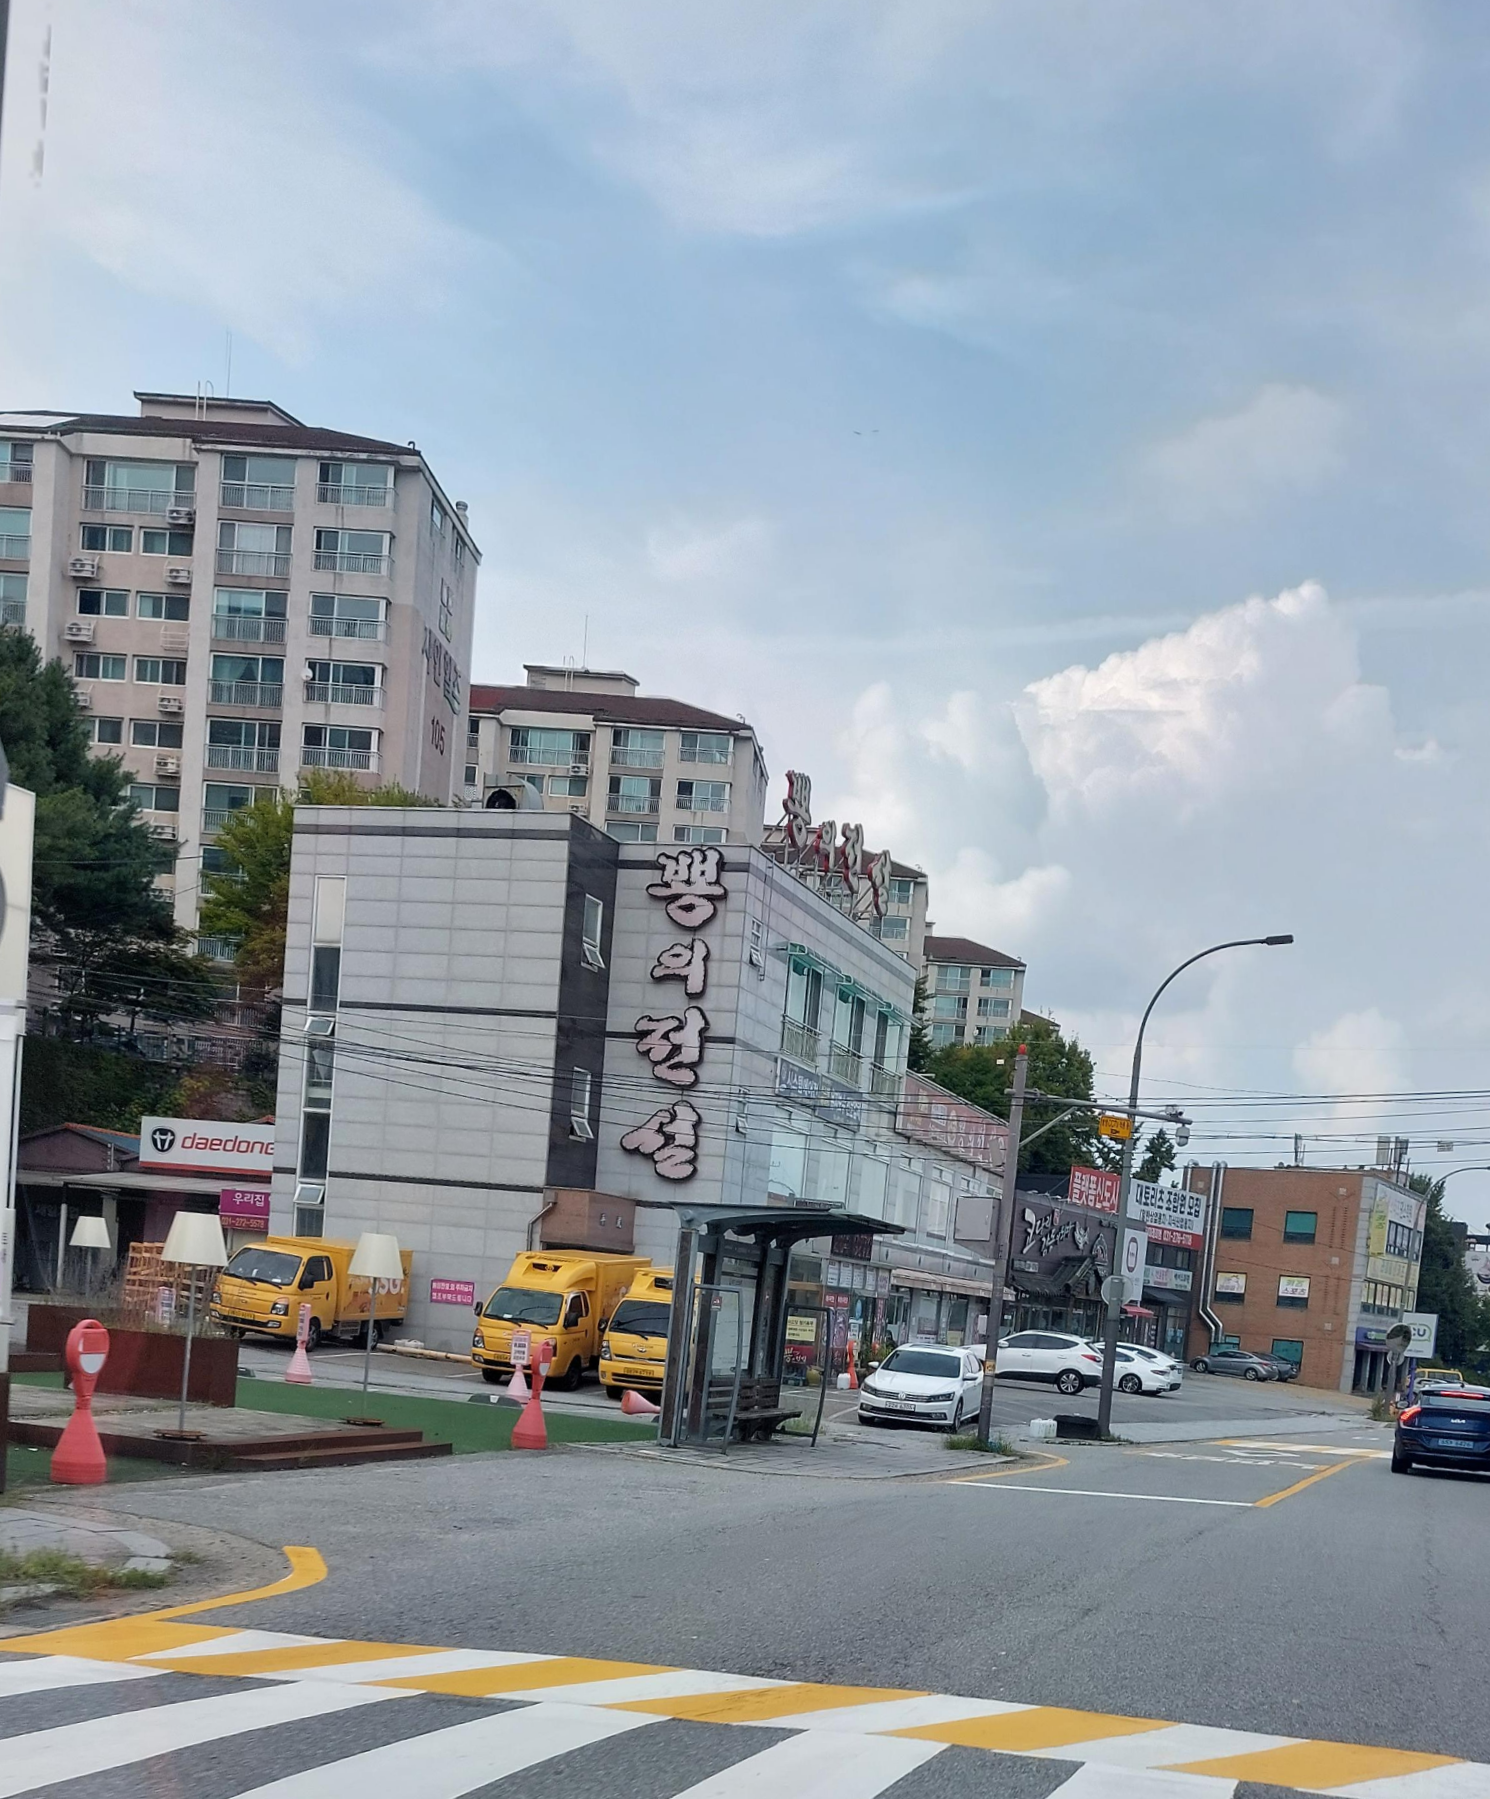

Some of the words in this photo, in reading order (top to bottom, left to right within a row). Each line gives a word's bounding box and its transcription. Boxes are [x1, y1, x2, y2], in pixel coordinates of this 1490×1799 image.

[431, 716, 446, 756] 105
[620, 846, 727, 1181] 뽕의전설
[232, 1192, 265, 1207] 우리집
[1072, 1171, 1120, 1213] 플랫폼신도시
[1165, 1190, 1186, 1215] 조합원
[1187, 1195, 1202, 1218] 모집
